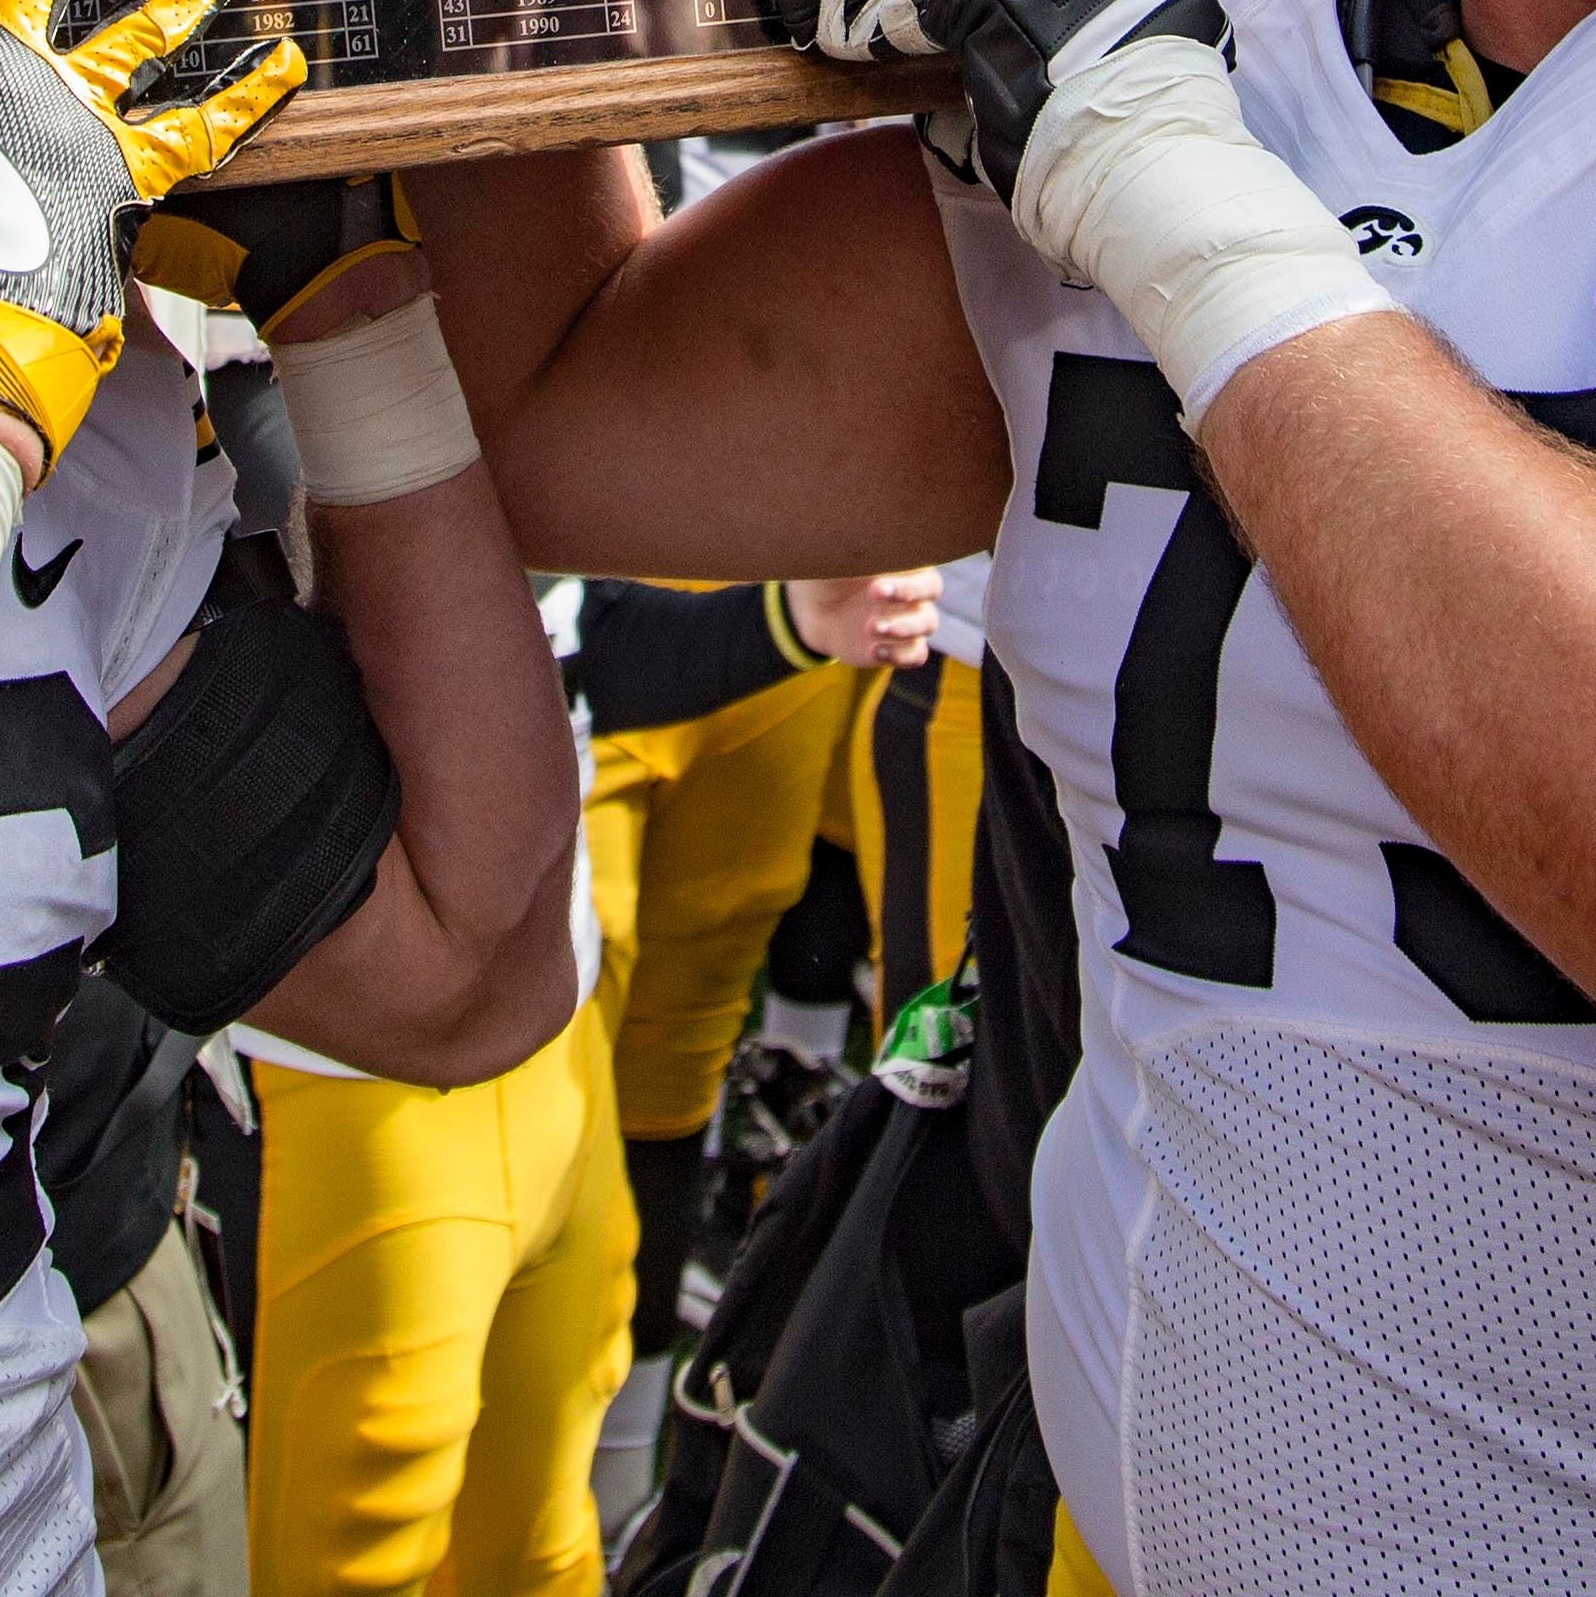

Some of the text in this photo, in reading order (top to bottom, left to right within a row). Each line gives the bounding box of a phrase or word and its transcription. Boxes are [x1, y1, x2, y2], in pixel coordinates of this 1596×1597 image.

[73, 0, 96, 19] 17
[252, 5, 369, 32] 1982 21
[704, 1, 715, 19] 0
[446, 10, 632, 44] 31 1990 24
[351, 35, 372, 53] 61
